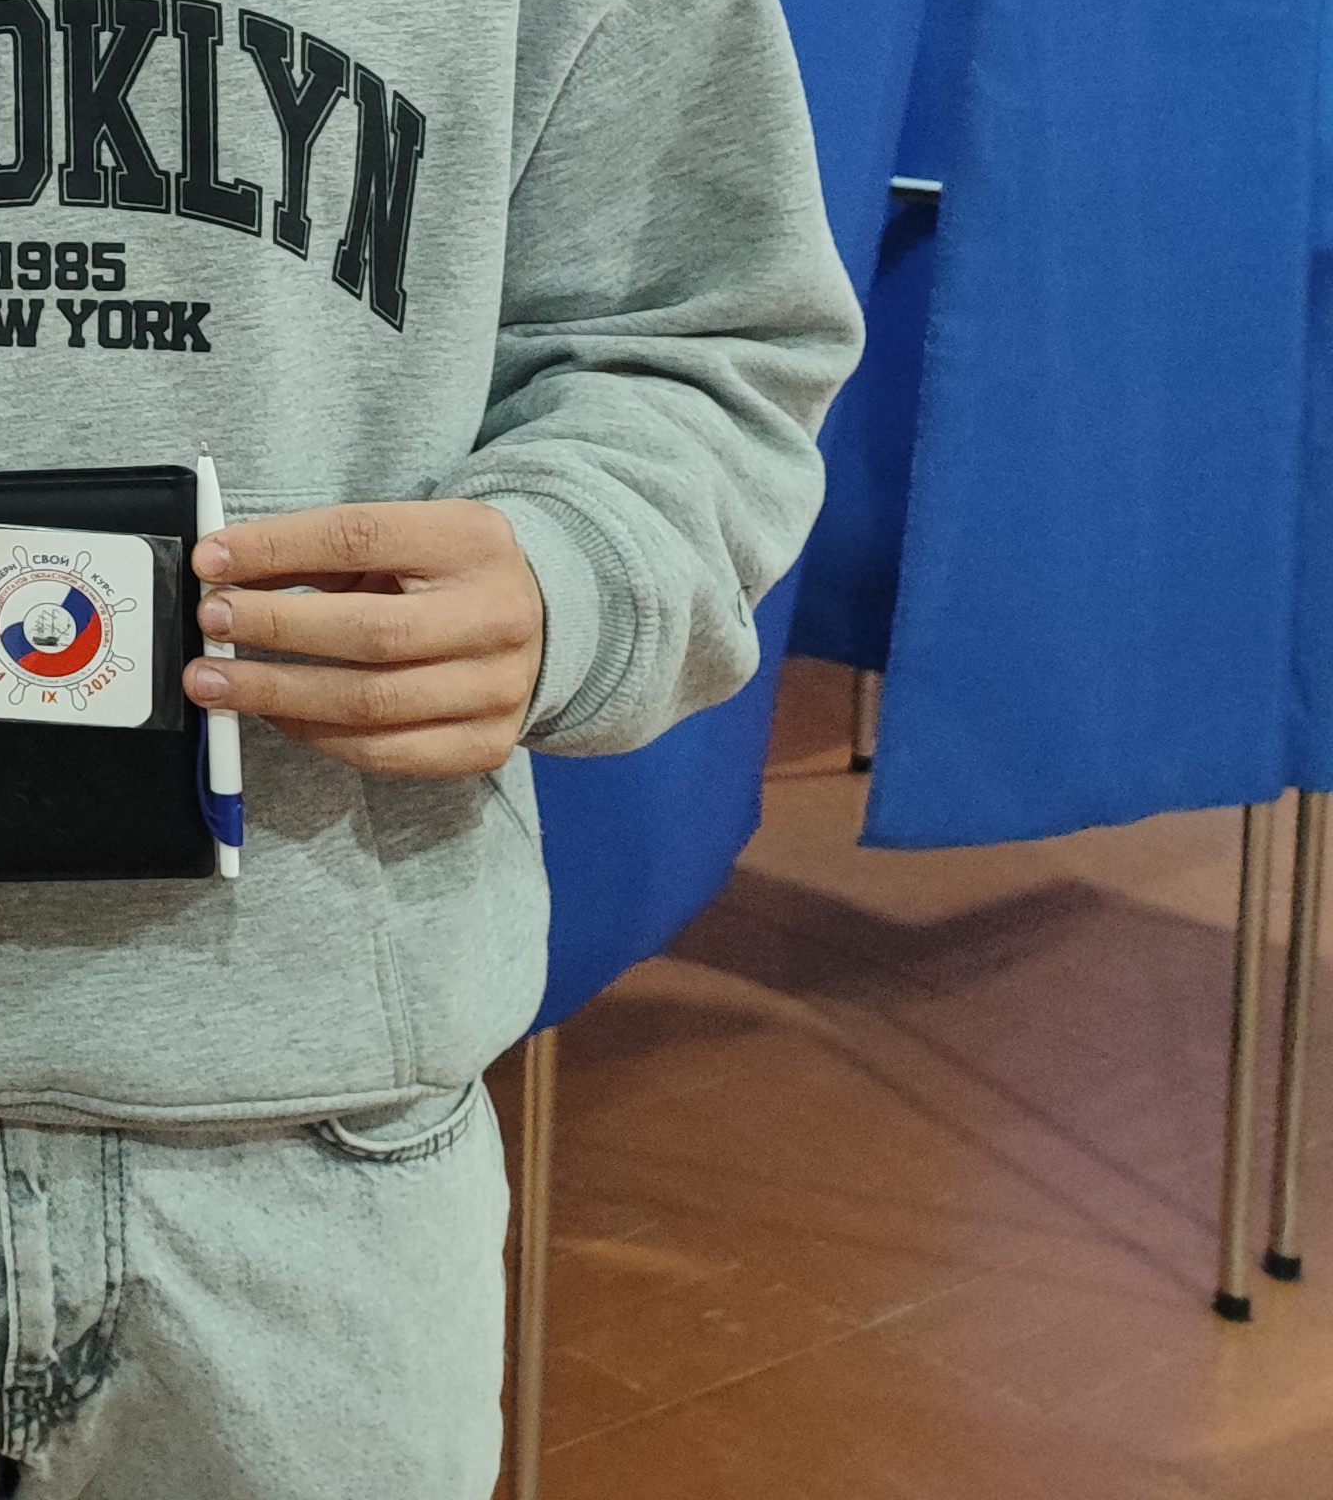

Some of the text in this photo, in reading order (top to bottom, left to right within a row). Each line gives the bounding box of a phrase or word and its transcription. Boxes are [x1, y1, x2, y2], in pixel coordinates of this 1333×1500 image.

[56, 297, 212, 353] YORK
[32, 554, 70, 567] СВОЙ
[91, 573, 115, 597] КУРС
[41, 690, 59, 704] IX
[83, 665, 117, 696] 2025
